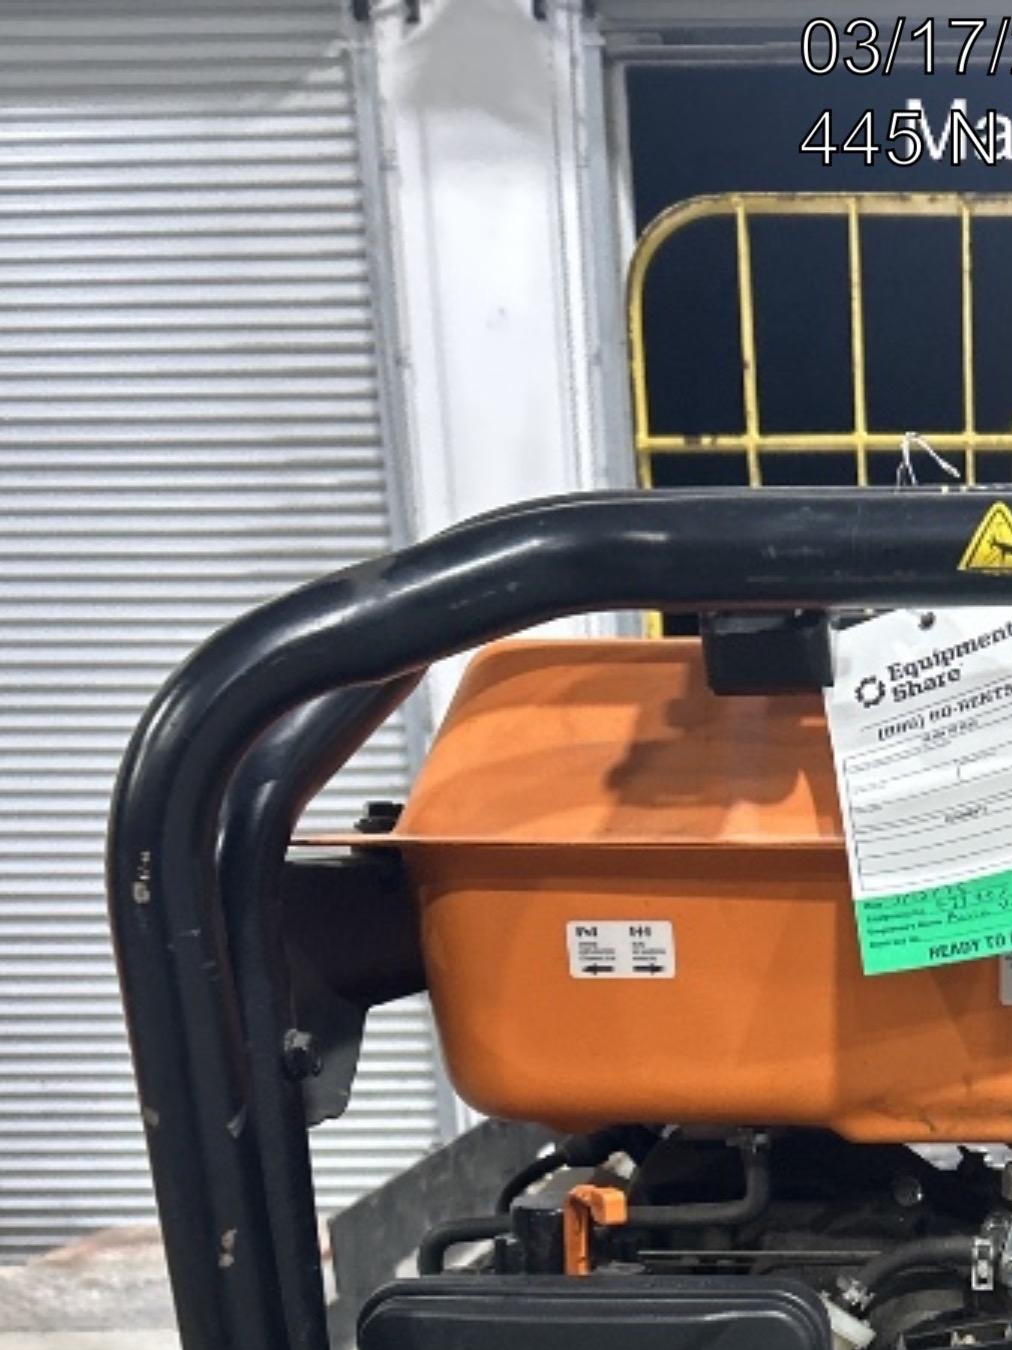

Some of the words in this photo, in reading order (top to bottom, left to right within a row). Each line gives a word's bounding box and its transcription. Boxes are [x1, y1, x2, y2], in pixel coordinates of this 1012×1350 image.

[890, 667, 962, 702] Share
[929, 941, 979, 960] READY
[984, 931, 1006, 949] TO
